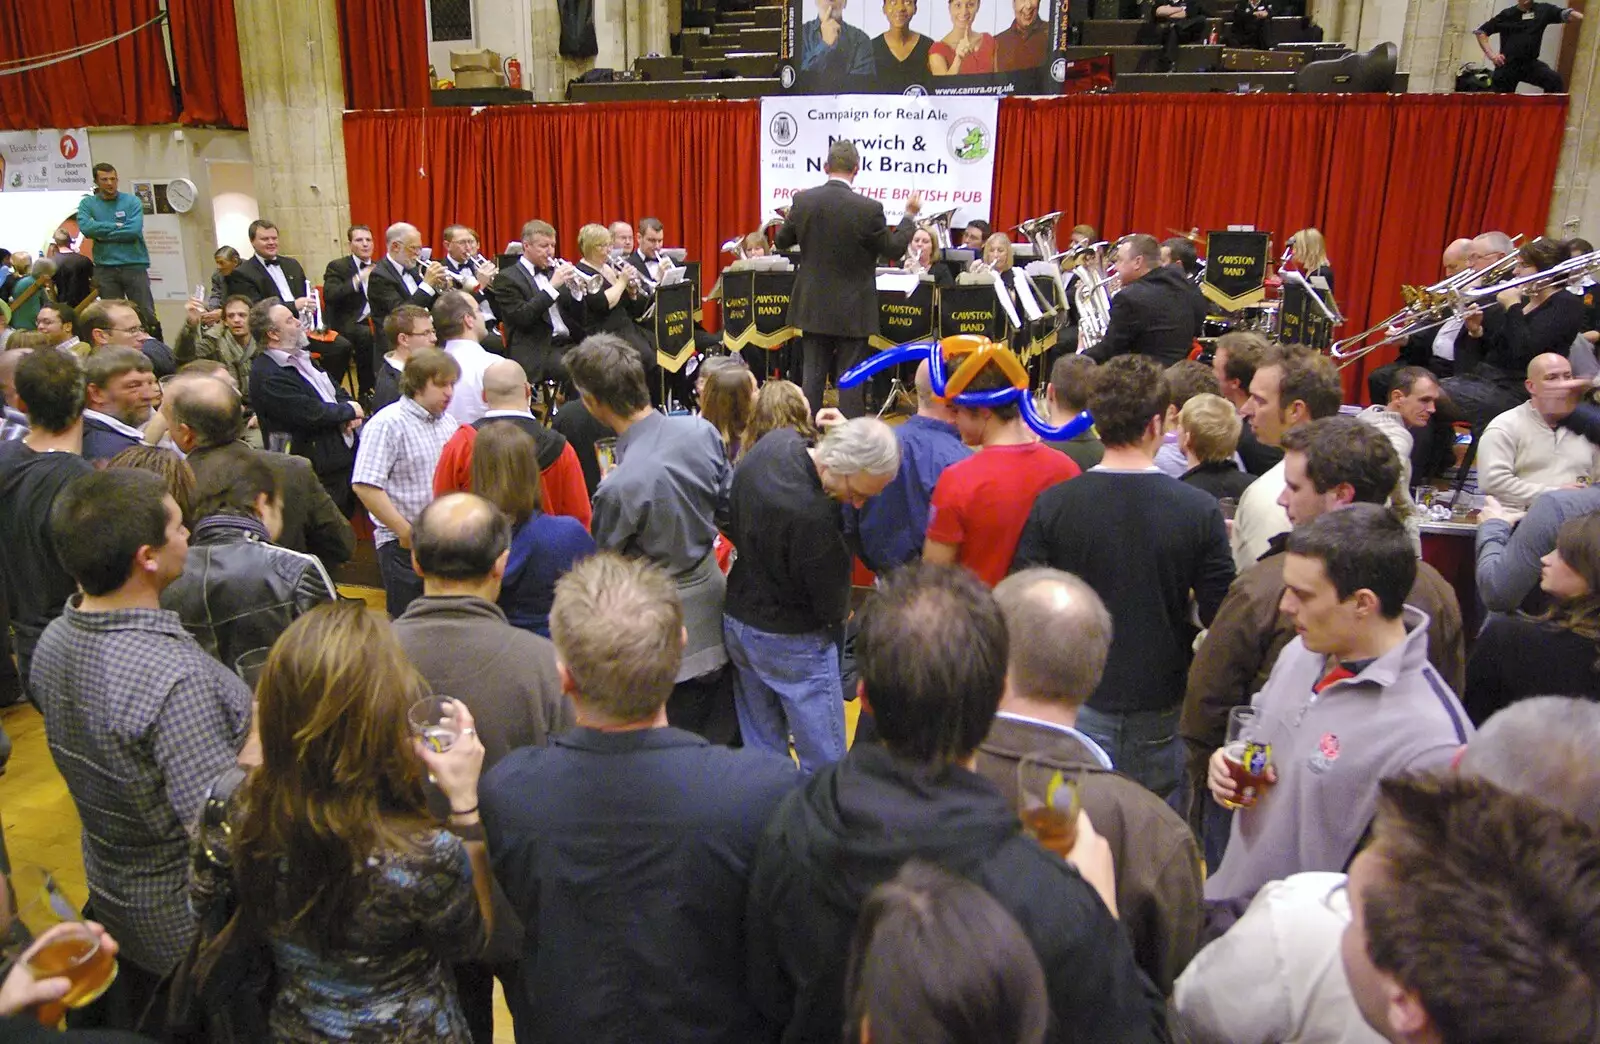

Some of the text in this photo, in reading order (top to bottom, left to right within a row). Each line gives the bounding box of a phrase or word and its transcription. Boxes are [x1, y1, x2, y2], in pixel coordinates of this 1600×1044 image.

[935, 83, 1014, 95] www.camra.org.uk
[807, 108, 948, 122] Campaign for Real Ale
[912, 136, 926, 151] &
[880, 156, 948, 174] Branch
[859, 187, 887, 200] THE
[953, 191, 982, 203] PUB
[1217, 255, 1256, 265] CAWSTON
[1223, 267, 1246, 276] BAND
[753, 294, 790, 304] AWSTON
[758, 306, 781, 315] BAND
[881, 304, 921, 315] CAWSTON
[951, 311, 993, 320] CAWSTON
[888, 316, 912, 326] BAND
[960, 323, 985, 332] BAND
